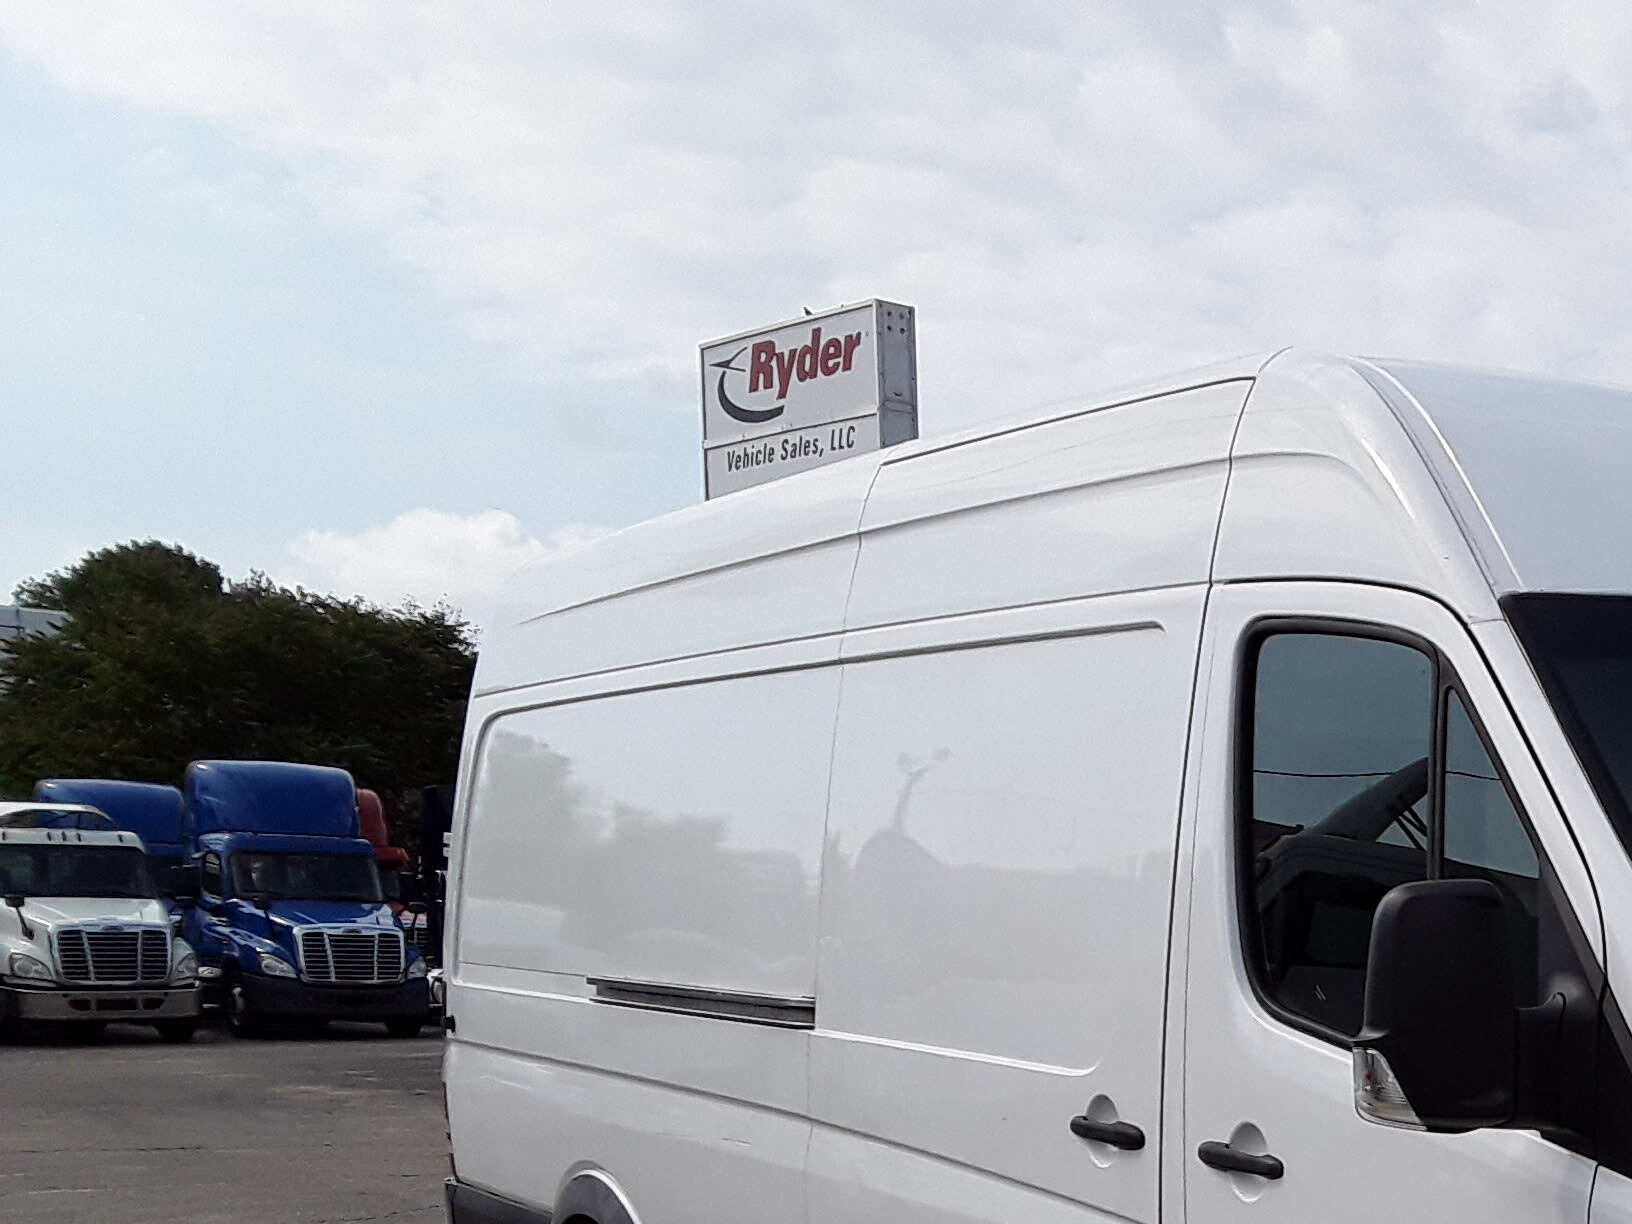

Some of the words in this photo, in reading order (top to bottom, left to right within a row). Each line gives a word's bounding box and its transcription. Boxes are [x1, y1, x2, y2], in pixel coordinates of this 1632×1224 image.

[748, 327, 861, 400] Ryder
[726, 443, 775, 472] Vehicle
[780, 435, 824, 459] Sales,
[830, 426, 856, 451] LLC
